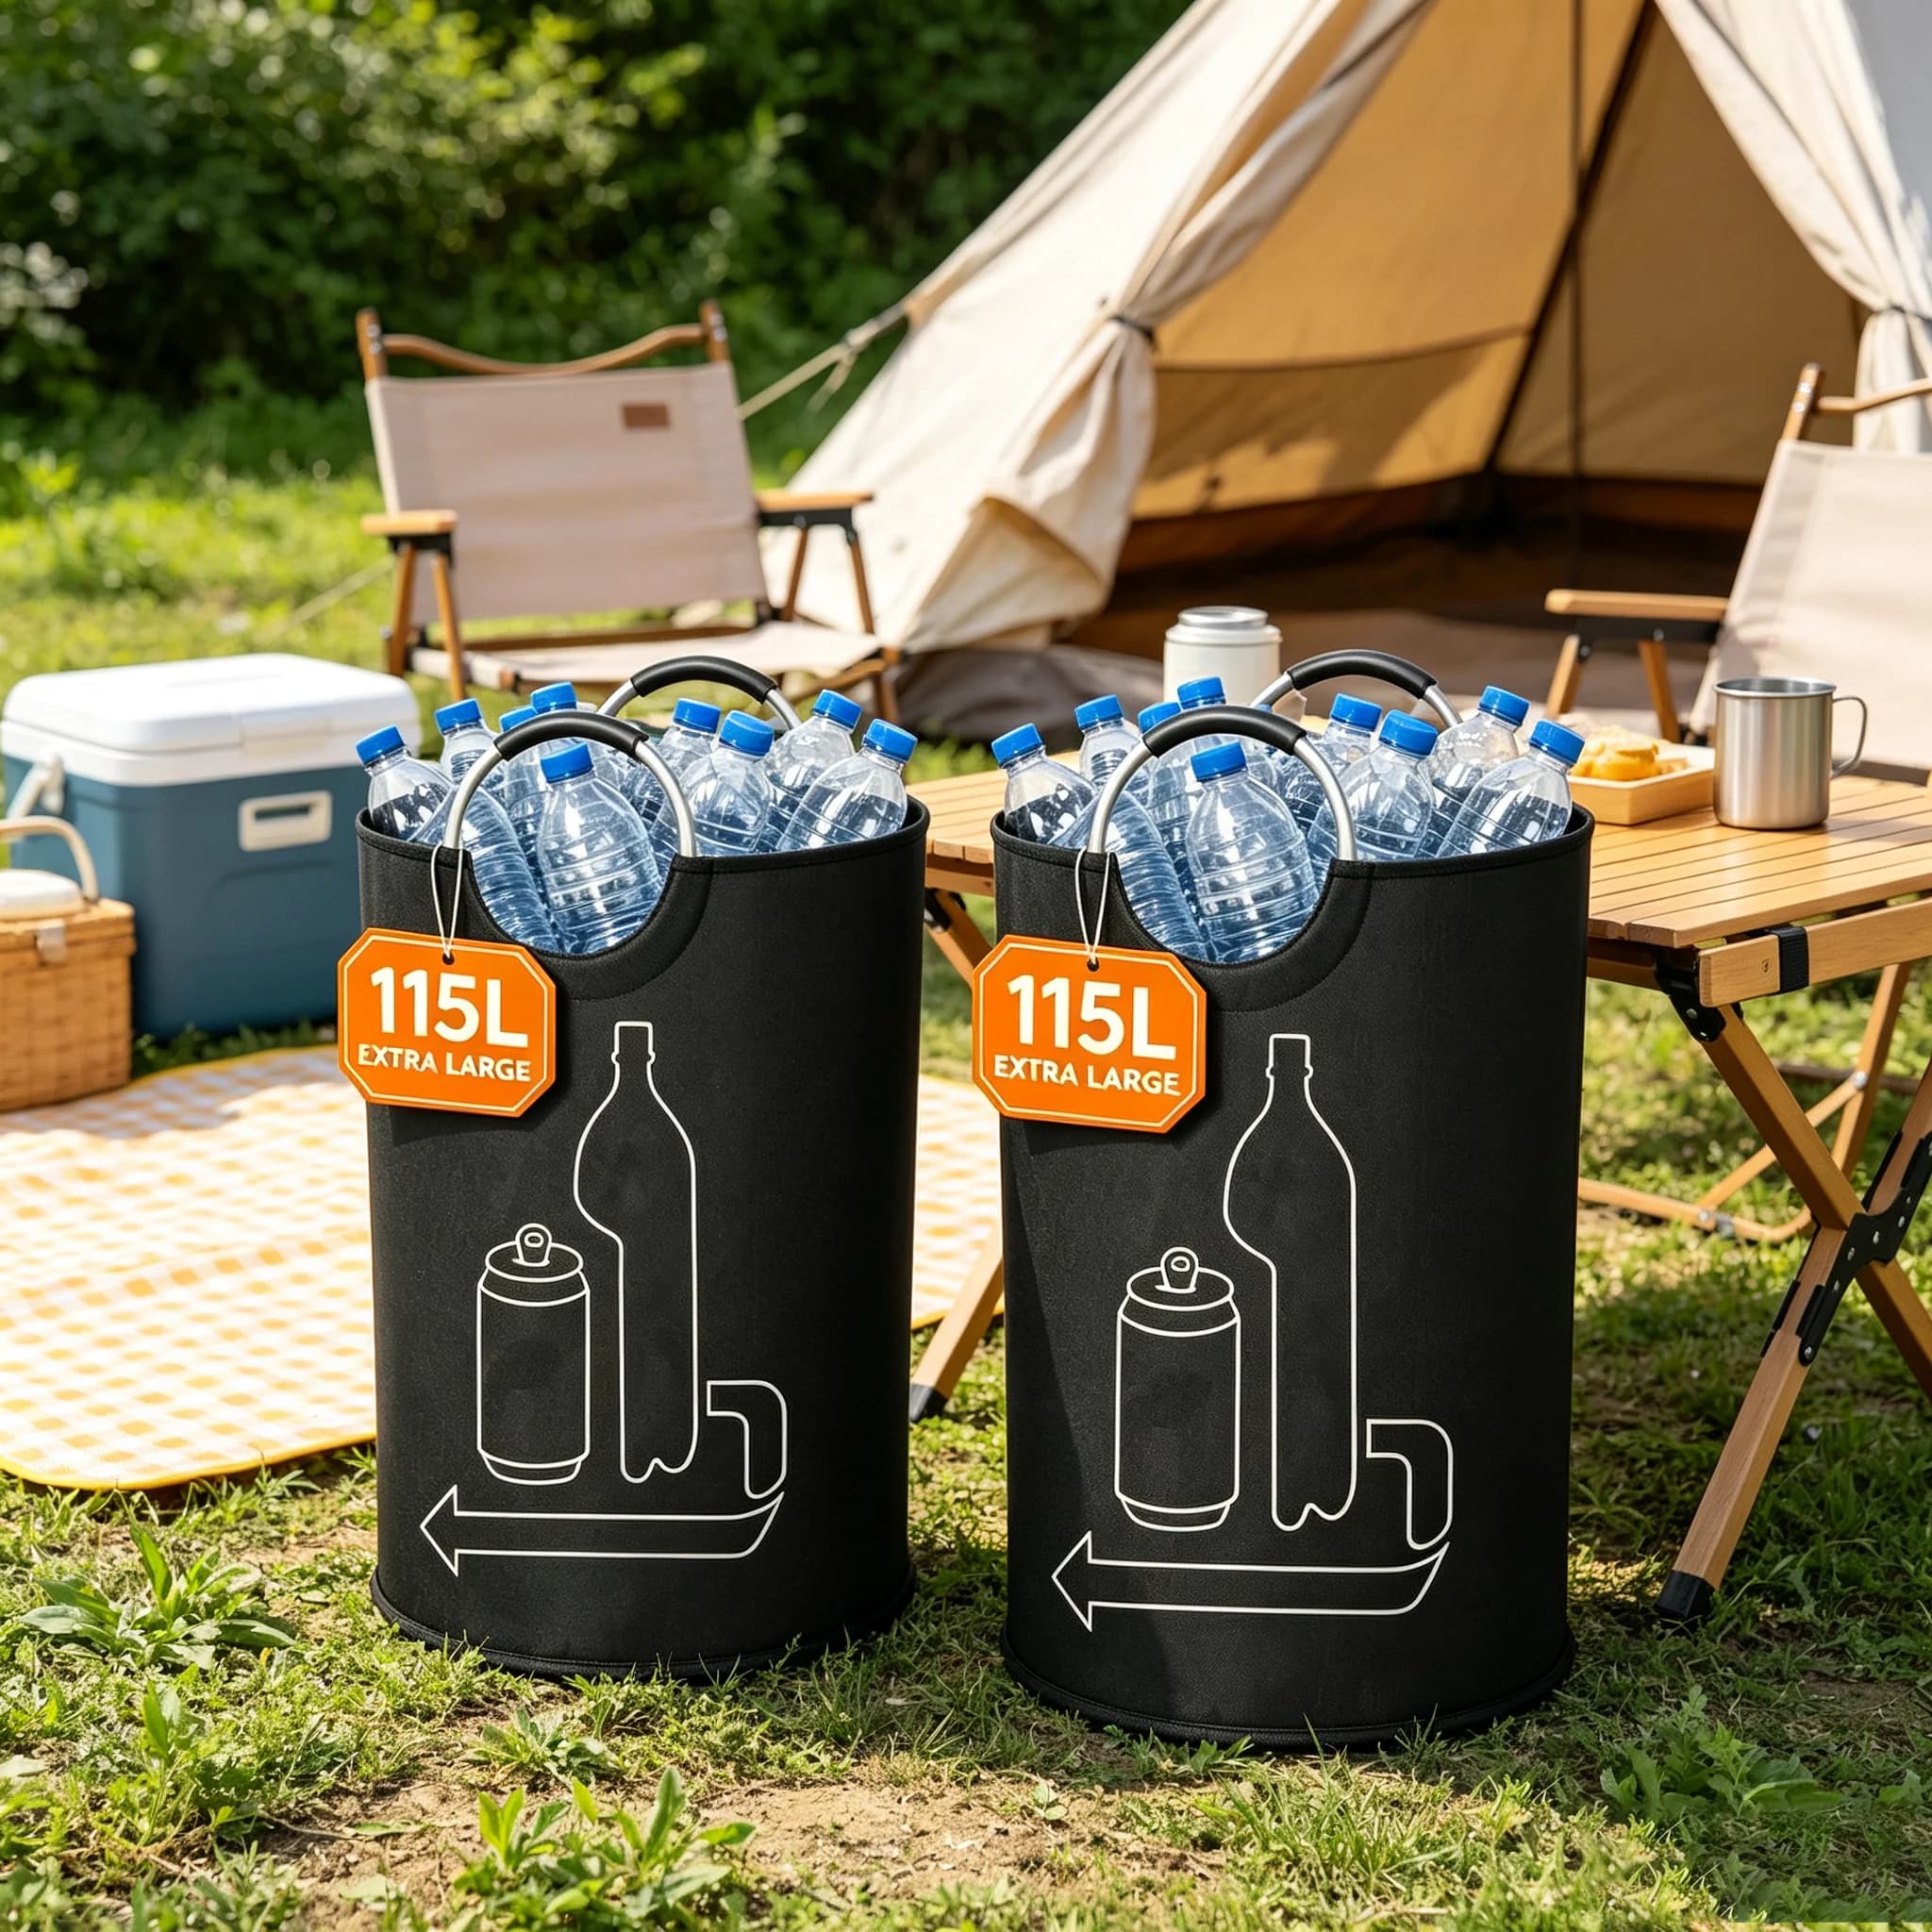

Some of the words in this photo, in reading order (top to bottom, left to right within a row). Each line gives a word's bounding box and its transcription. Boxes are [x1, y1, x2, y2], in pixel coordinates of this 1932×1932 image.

[370, 966, 529, 1048] 115L
[1007, 974, 1177, 1060] 115L
[358, 1042, 439, 1074] EXTRA
[445, 1052, 531, 1083] LARGE
[993, 1054, 1079, 1087] EXTRA
[1087, 1064, 1181, 1097] LARGE
